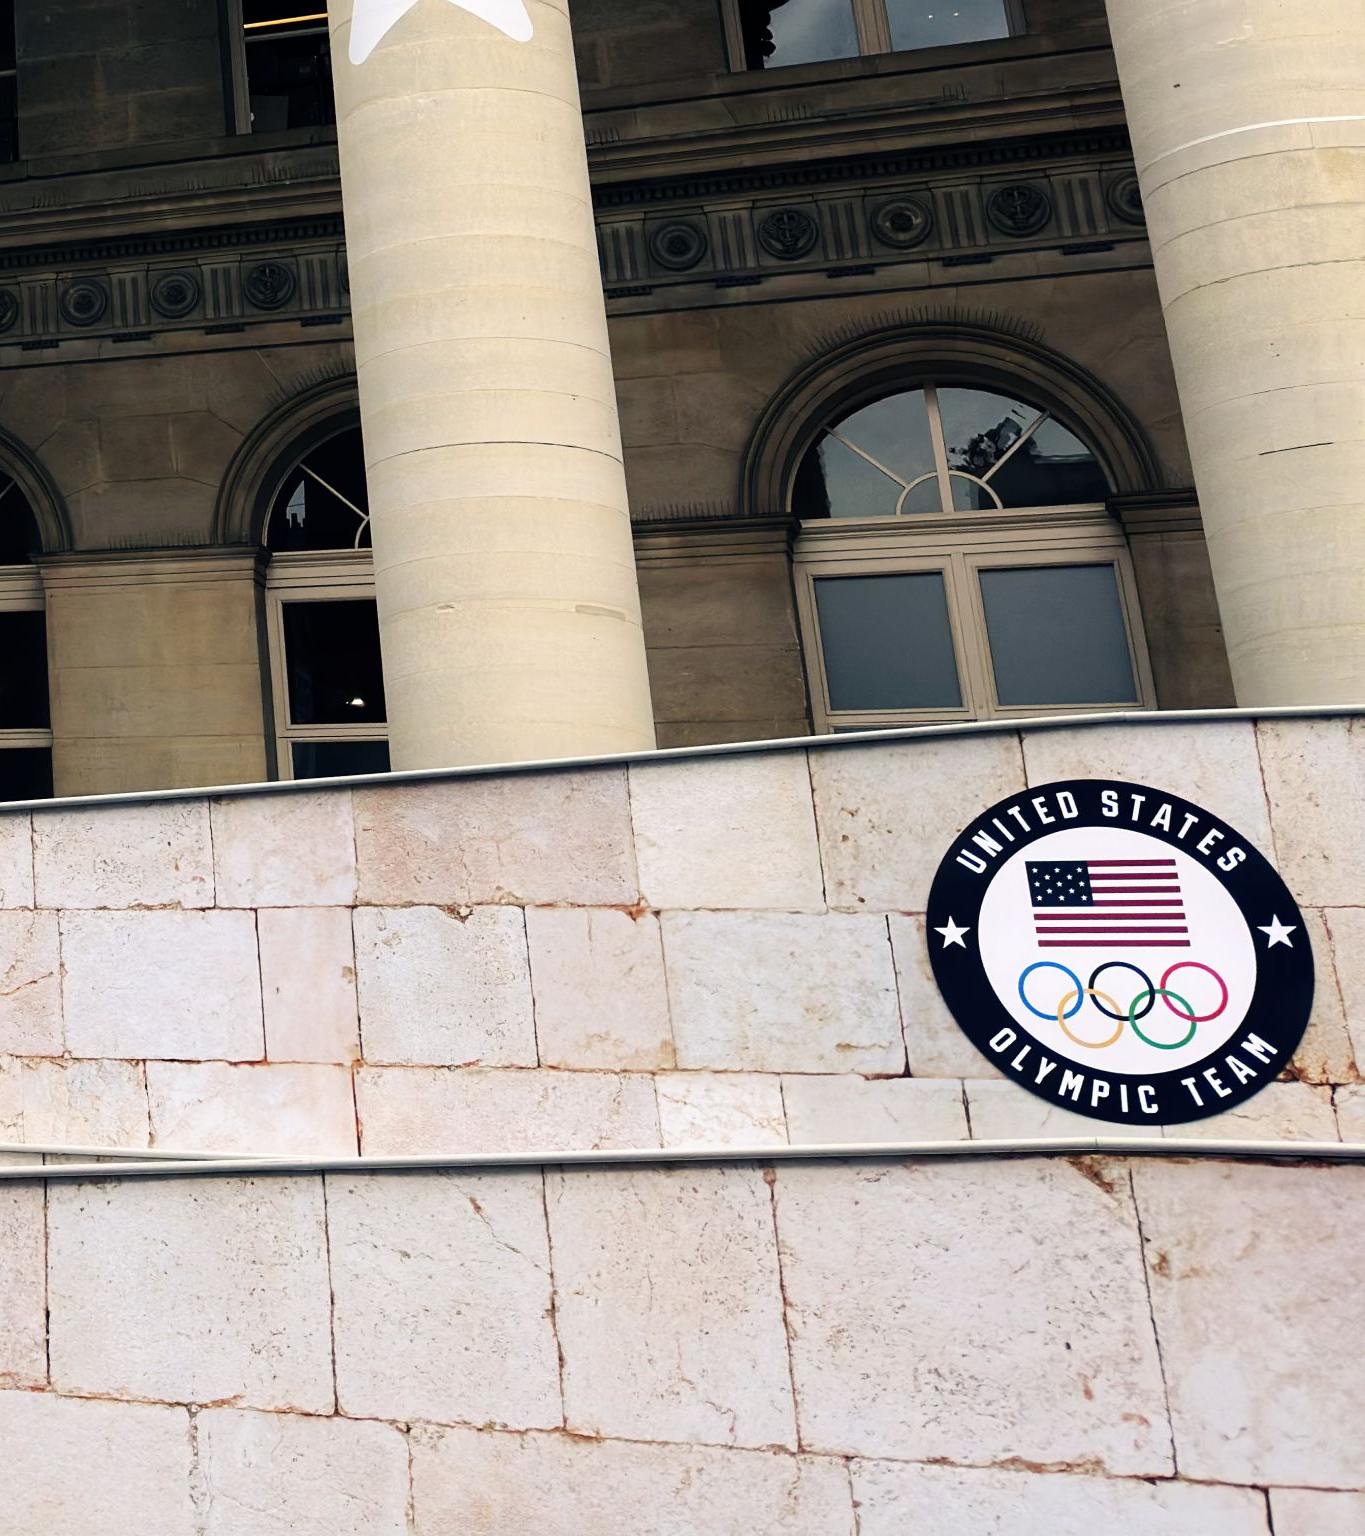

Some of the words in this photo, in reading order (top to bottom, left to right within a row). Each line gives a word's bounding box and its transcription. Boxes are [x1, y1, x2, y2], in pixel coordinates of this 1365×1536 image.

[954, 790, 1080, 875] UNITED
[1100, 789, 1248, 873] STATES
[988, 1026, 1160, 1115] OLYMPIC
[1179, 1031, 1279, 1108] TEAM
